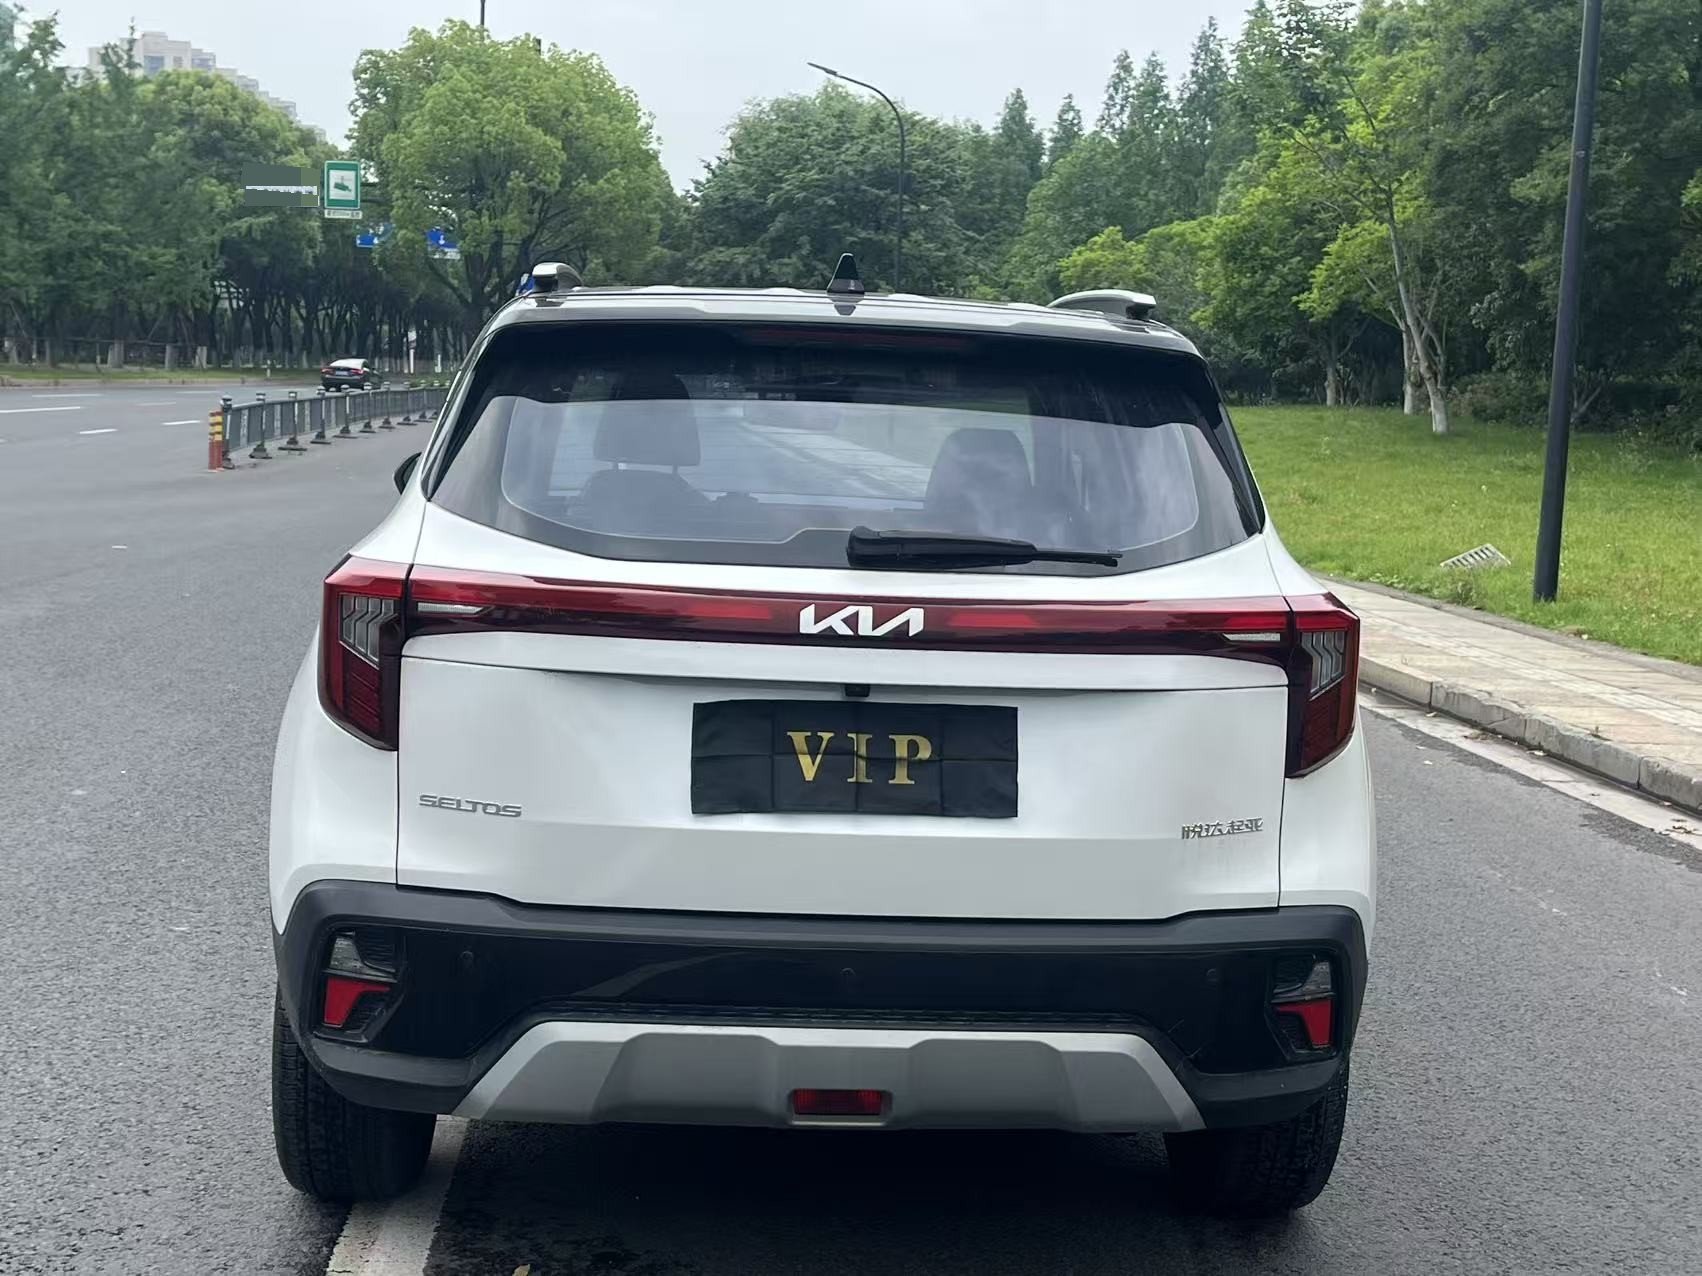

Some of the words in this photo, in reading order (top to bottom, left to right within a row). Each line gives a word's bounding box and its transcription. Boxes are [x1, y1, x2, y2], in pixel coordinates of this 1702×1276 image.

[799, 603, 925, 637] KIA
[786, 731, 932, 785] VIP
[419, 794, 522, 818] SELTOS
[1181, 817, 1264, 839] 悦达起亚
